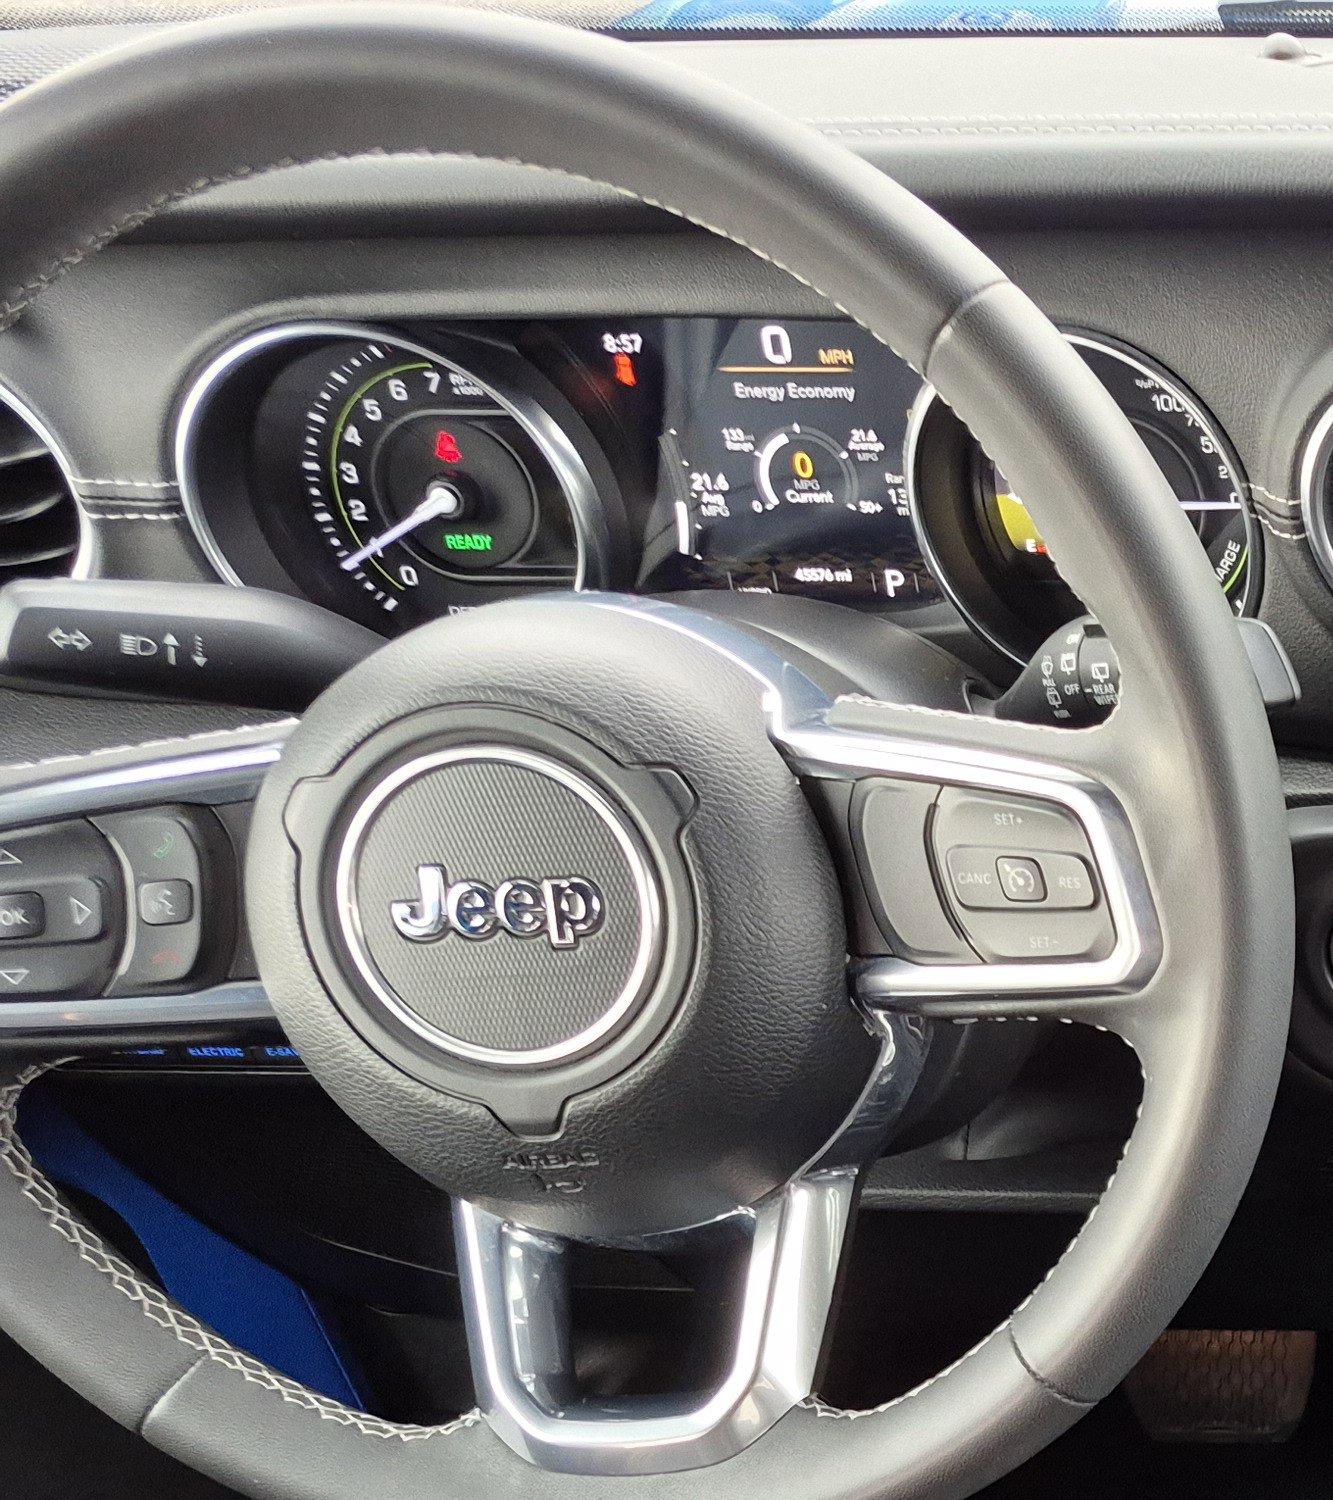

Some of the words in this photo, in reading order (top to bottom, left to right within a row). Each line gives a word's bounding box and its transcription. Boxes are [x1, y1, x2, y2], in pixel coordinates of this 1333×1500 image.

[602, 333, 643, 354] 8:57
[760, 325, 793, 365] 0
[818, 349, 854, 365] MPH
[388, 378, 409, 401] 6
[422, 371, 441, 394] 7
[733, 381, 785, 402] Energy
[786, 381, 856, 403] Economy
[362, 398, 382, 422] 5
[343, 423, 364, 447] 4
[850, 428, 878, 443] 21.6
[339, 461, 360, 485] 3
[792, 450, 814, 480] 0
[689, 471, 730, 492] 21.6
[793, 478, 820, 491] MPG
[751, 499, 764, 514] 0
[784, 487, 835, 505] Current
[347, 498, 370, 522] 2
[701, 503, 731, 518] MPG
[444, 534, 493, 551] READY
[1026, 538, 1038, 553] E
[399, 564, 419, 587] 0
[883, 568, 905, 598] P
[1064, 683, 1081, 695] OFF
[1093, 683, 1116, 694] REAR
[957, 872, 992, 886] CANC
[1058, 876, 1082, 890] RES
[391, 862, 606, 950] Jeep
[188, 1046, 245, 1058] ELECTRIC
